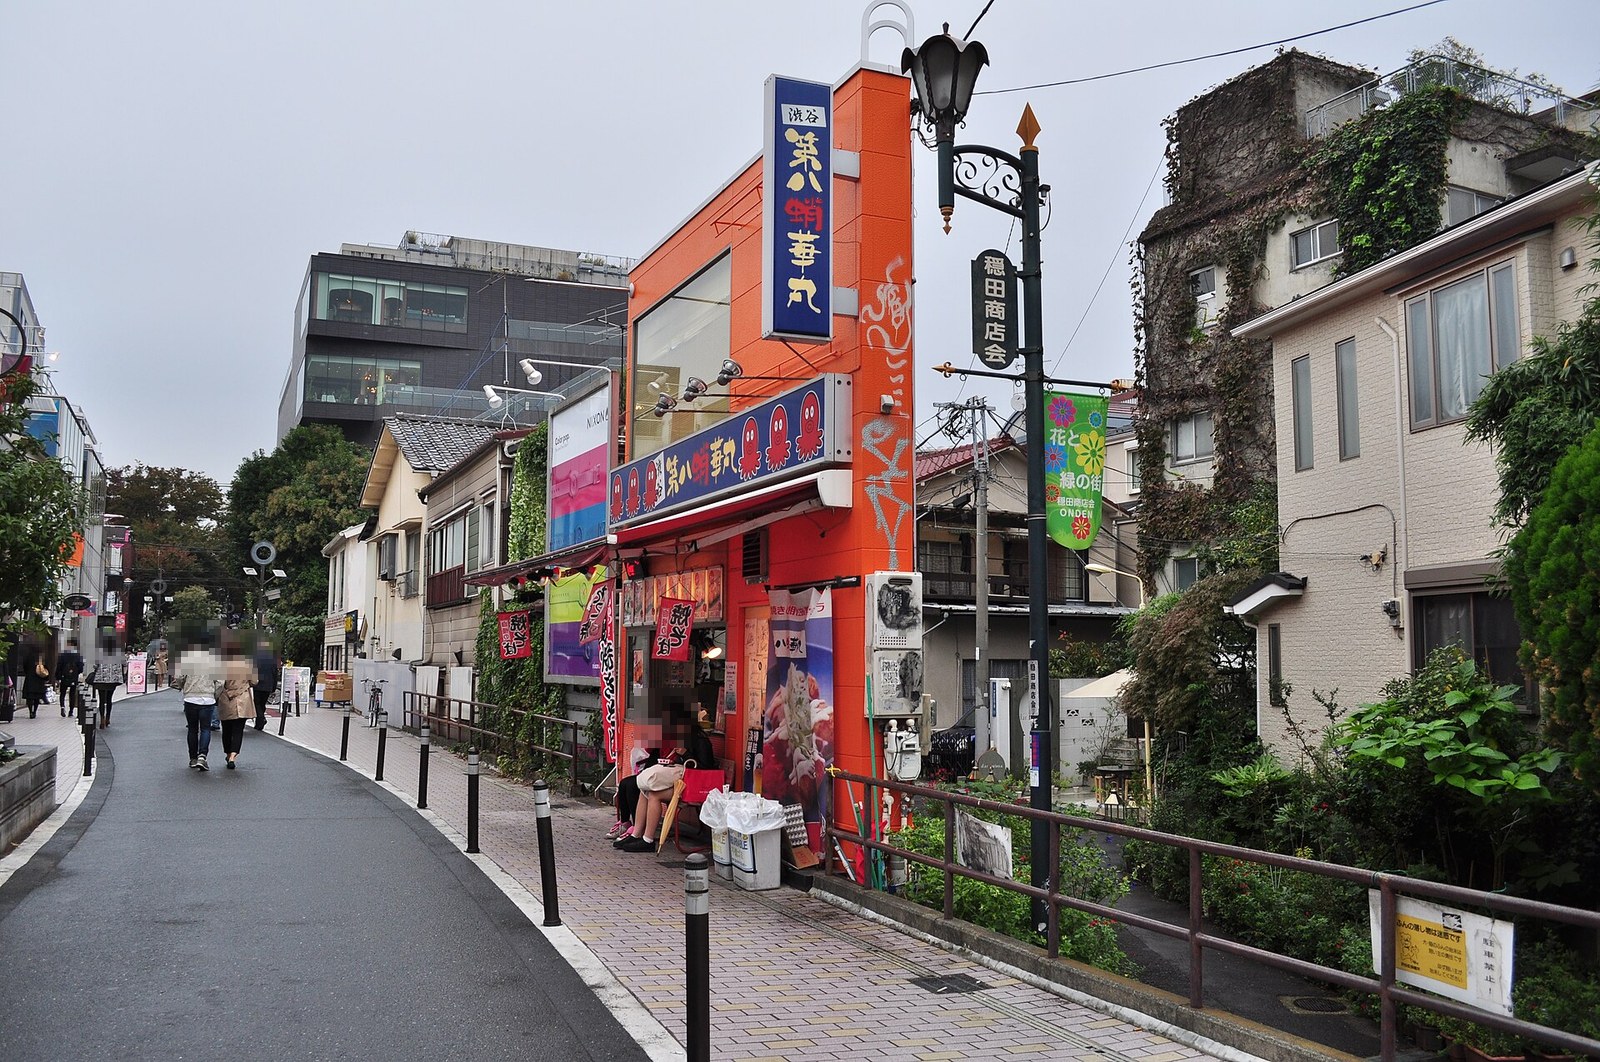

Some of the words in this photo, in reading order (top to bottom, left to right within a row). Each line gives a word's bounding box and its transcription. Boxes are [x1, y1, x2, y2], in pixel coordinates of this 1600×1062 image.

[788, 106, 818, 124] 渋谷
[984, 256, 1006, 364] 穏田商店会
[1050, 428, 1081, 447] 花と
[1060, 472, 1101, 492] 緑の街
[1060, 508, 1092, 519] ONDEN
